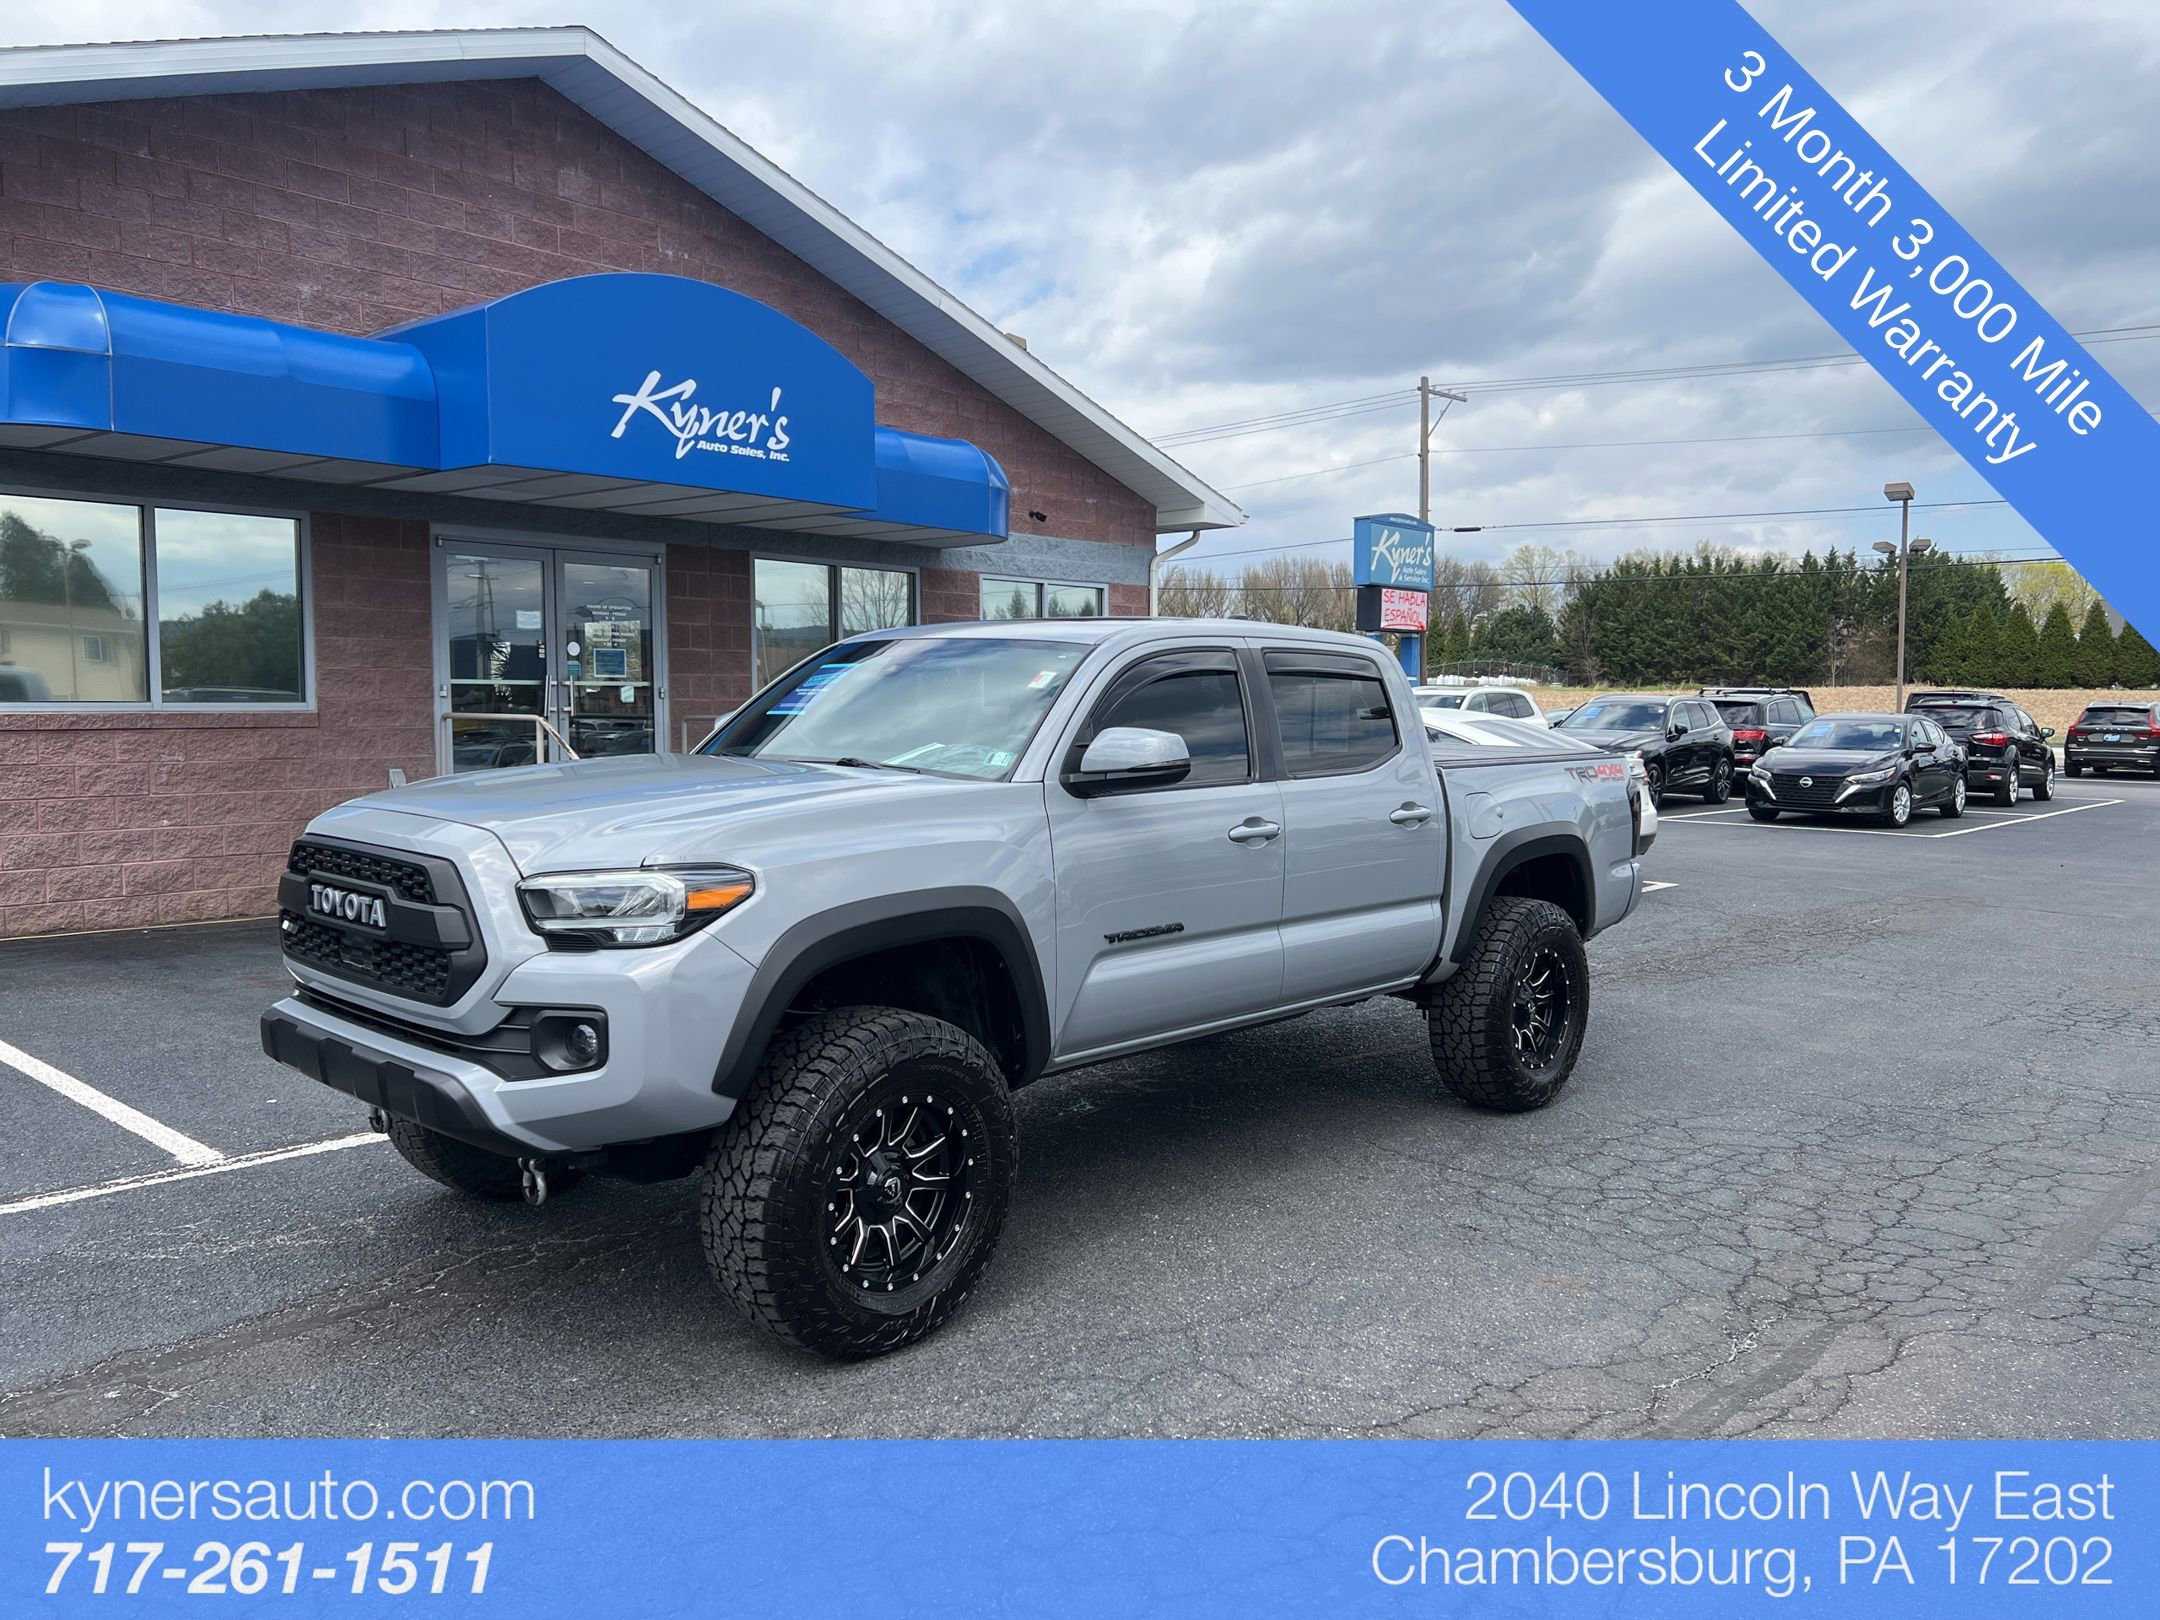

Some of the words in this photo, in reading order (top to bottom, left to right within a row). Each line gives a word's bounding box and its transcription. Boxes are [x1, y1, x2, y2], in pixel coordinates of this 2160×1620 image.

[611, 369, 790, 460] Kyner's
[697, 440, 728, 453] Auto
[730, 444, 766, 460] Sales,
[769, 451, 790, 462] Inc.
[1370, 529, 1431, 584] Kyner's
[1383, 590, 1396, 604] SE
[1398, 591, 1426, 607] HABLA
[1384, 607, 1423, 624] ESPAÑOL
[1564, 766, 1597, 784] TRD
[311, 884, 387, 928] TOYOTA
[1103, 921, 1185, 944] TACOMA
